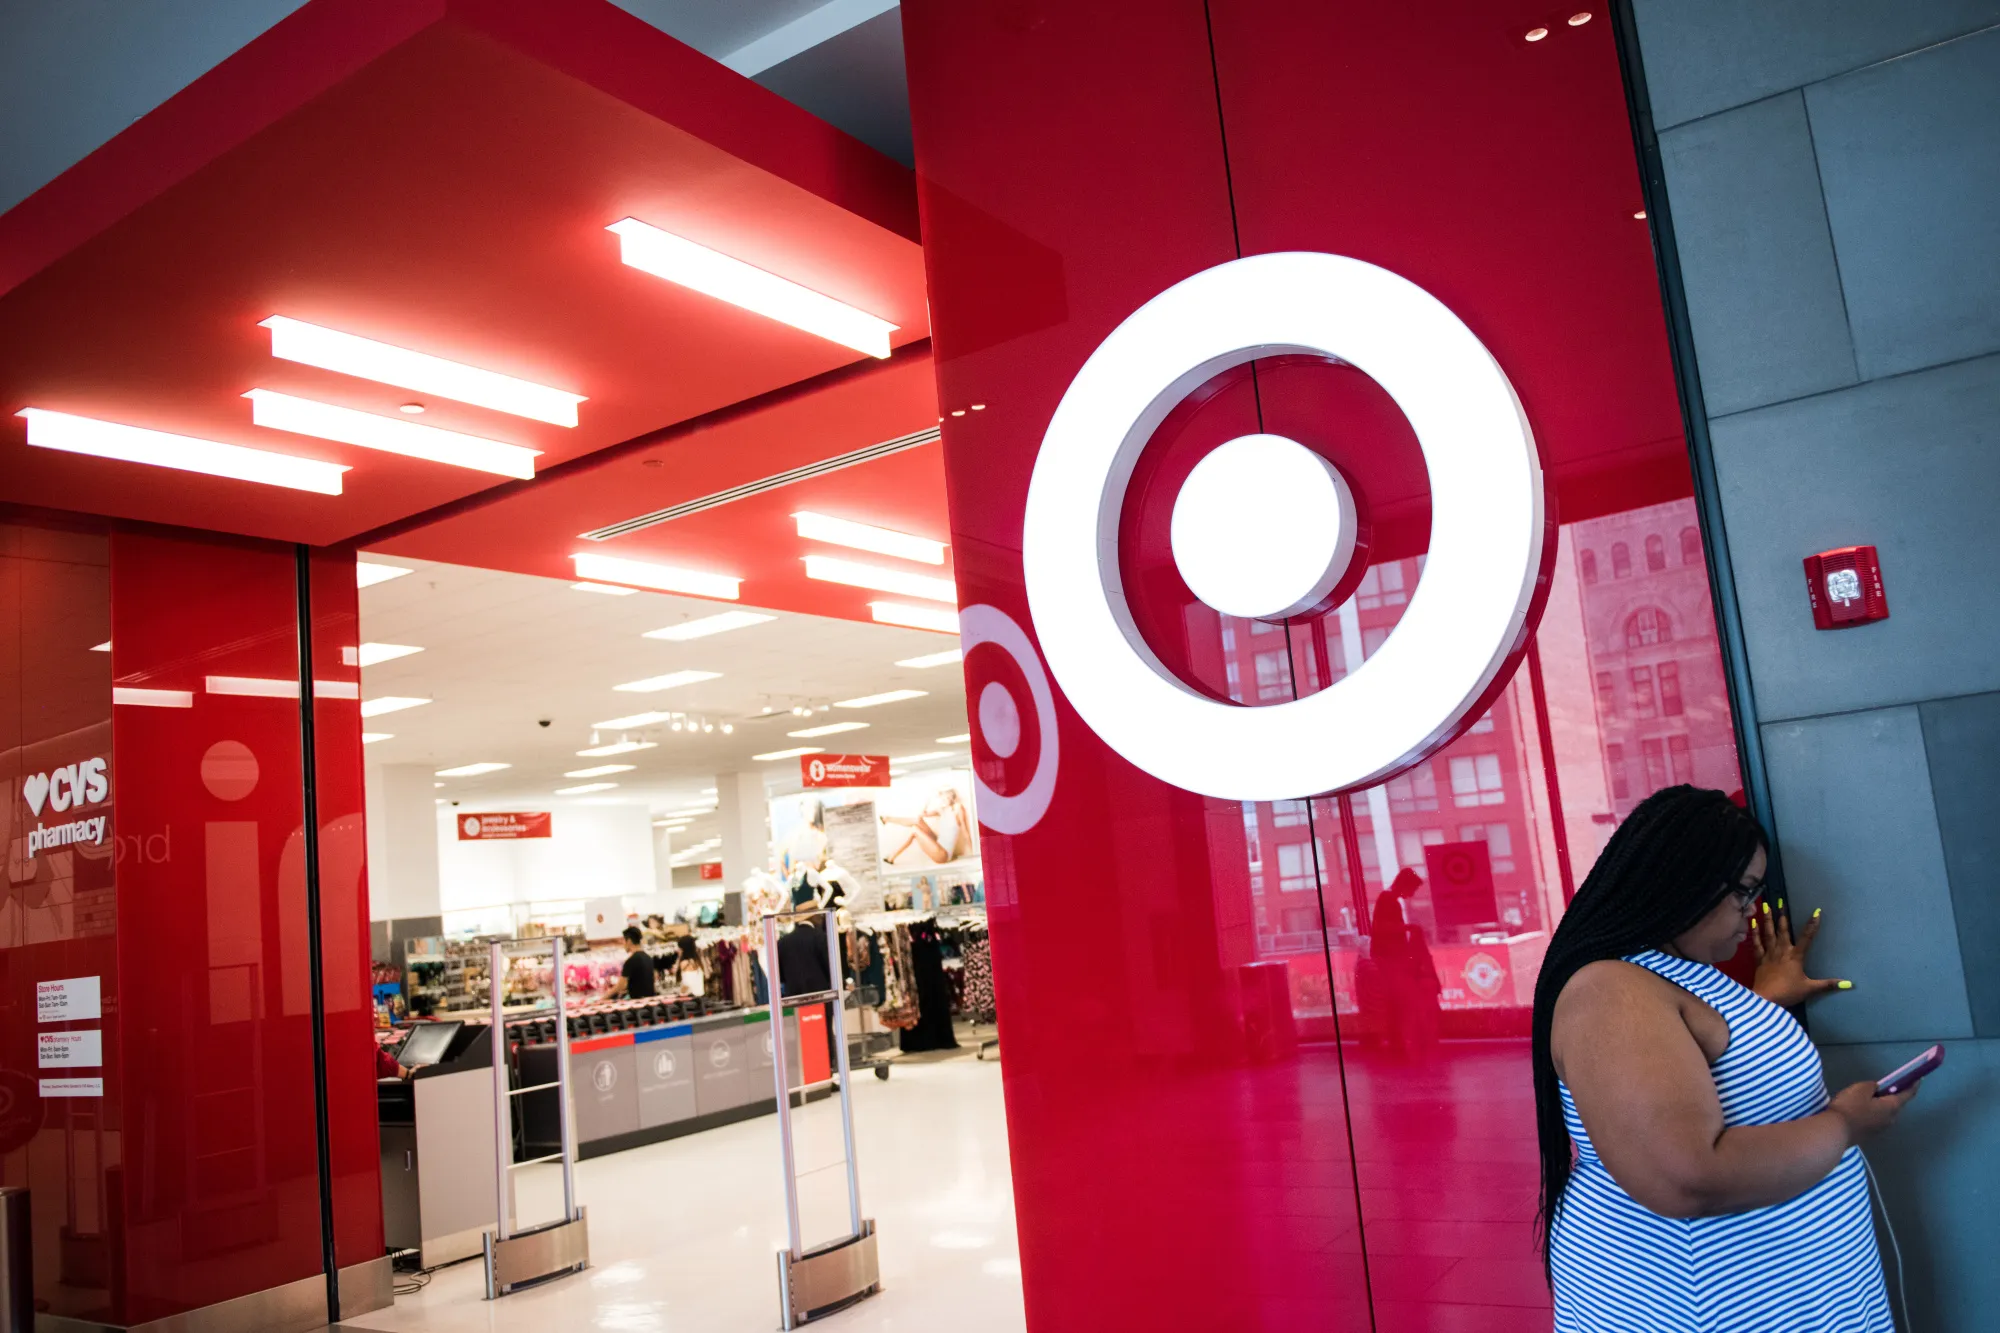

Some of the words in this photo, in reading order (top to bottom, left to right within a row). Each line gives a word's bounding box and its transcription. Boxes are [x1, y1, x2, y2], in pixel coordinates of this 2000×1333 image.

[1808, 578, 1817, 609] FIRE
[1871, 566, 1882, 597] FIRE
[50, 757, 108, 812] CVS
[28, 816, 106, 859] pharmacy
[50, 984, 64, 992] Hours
